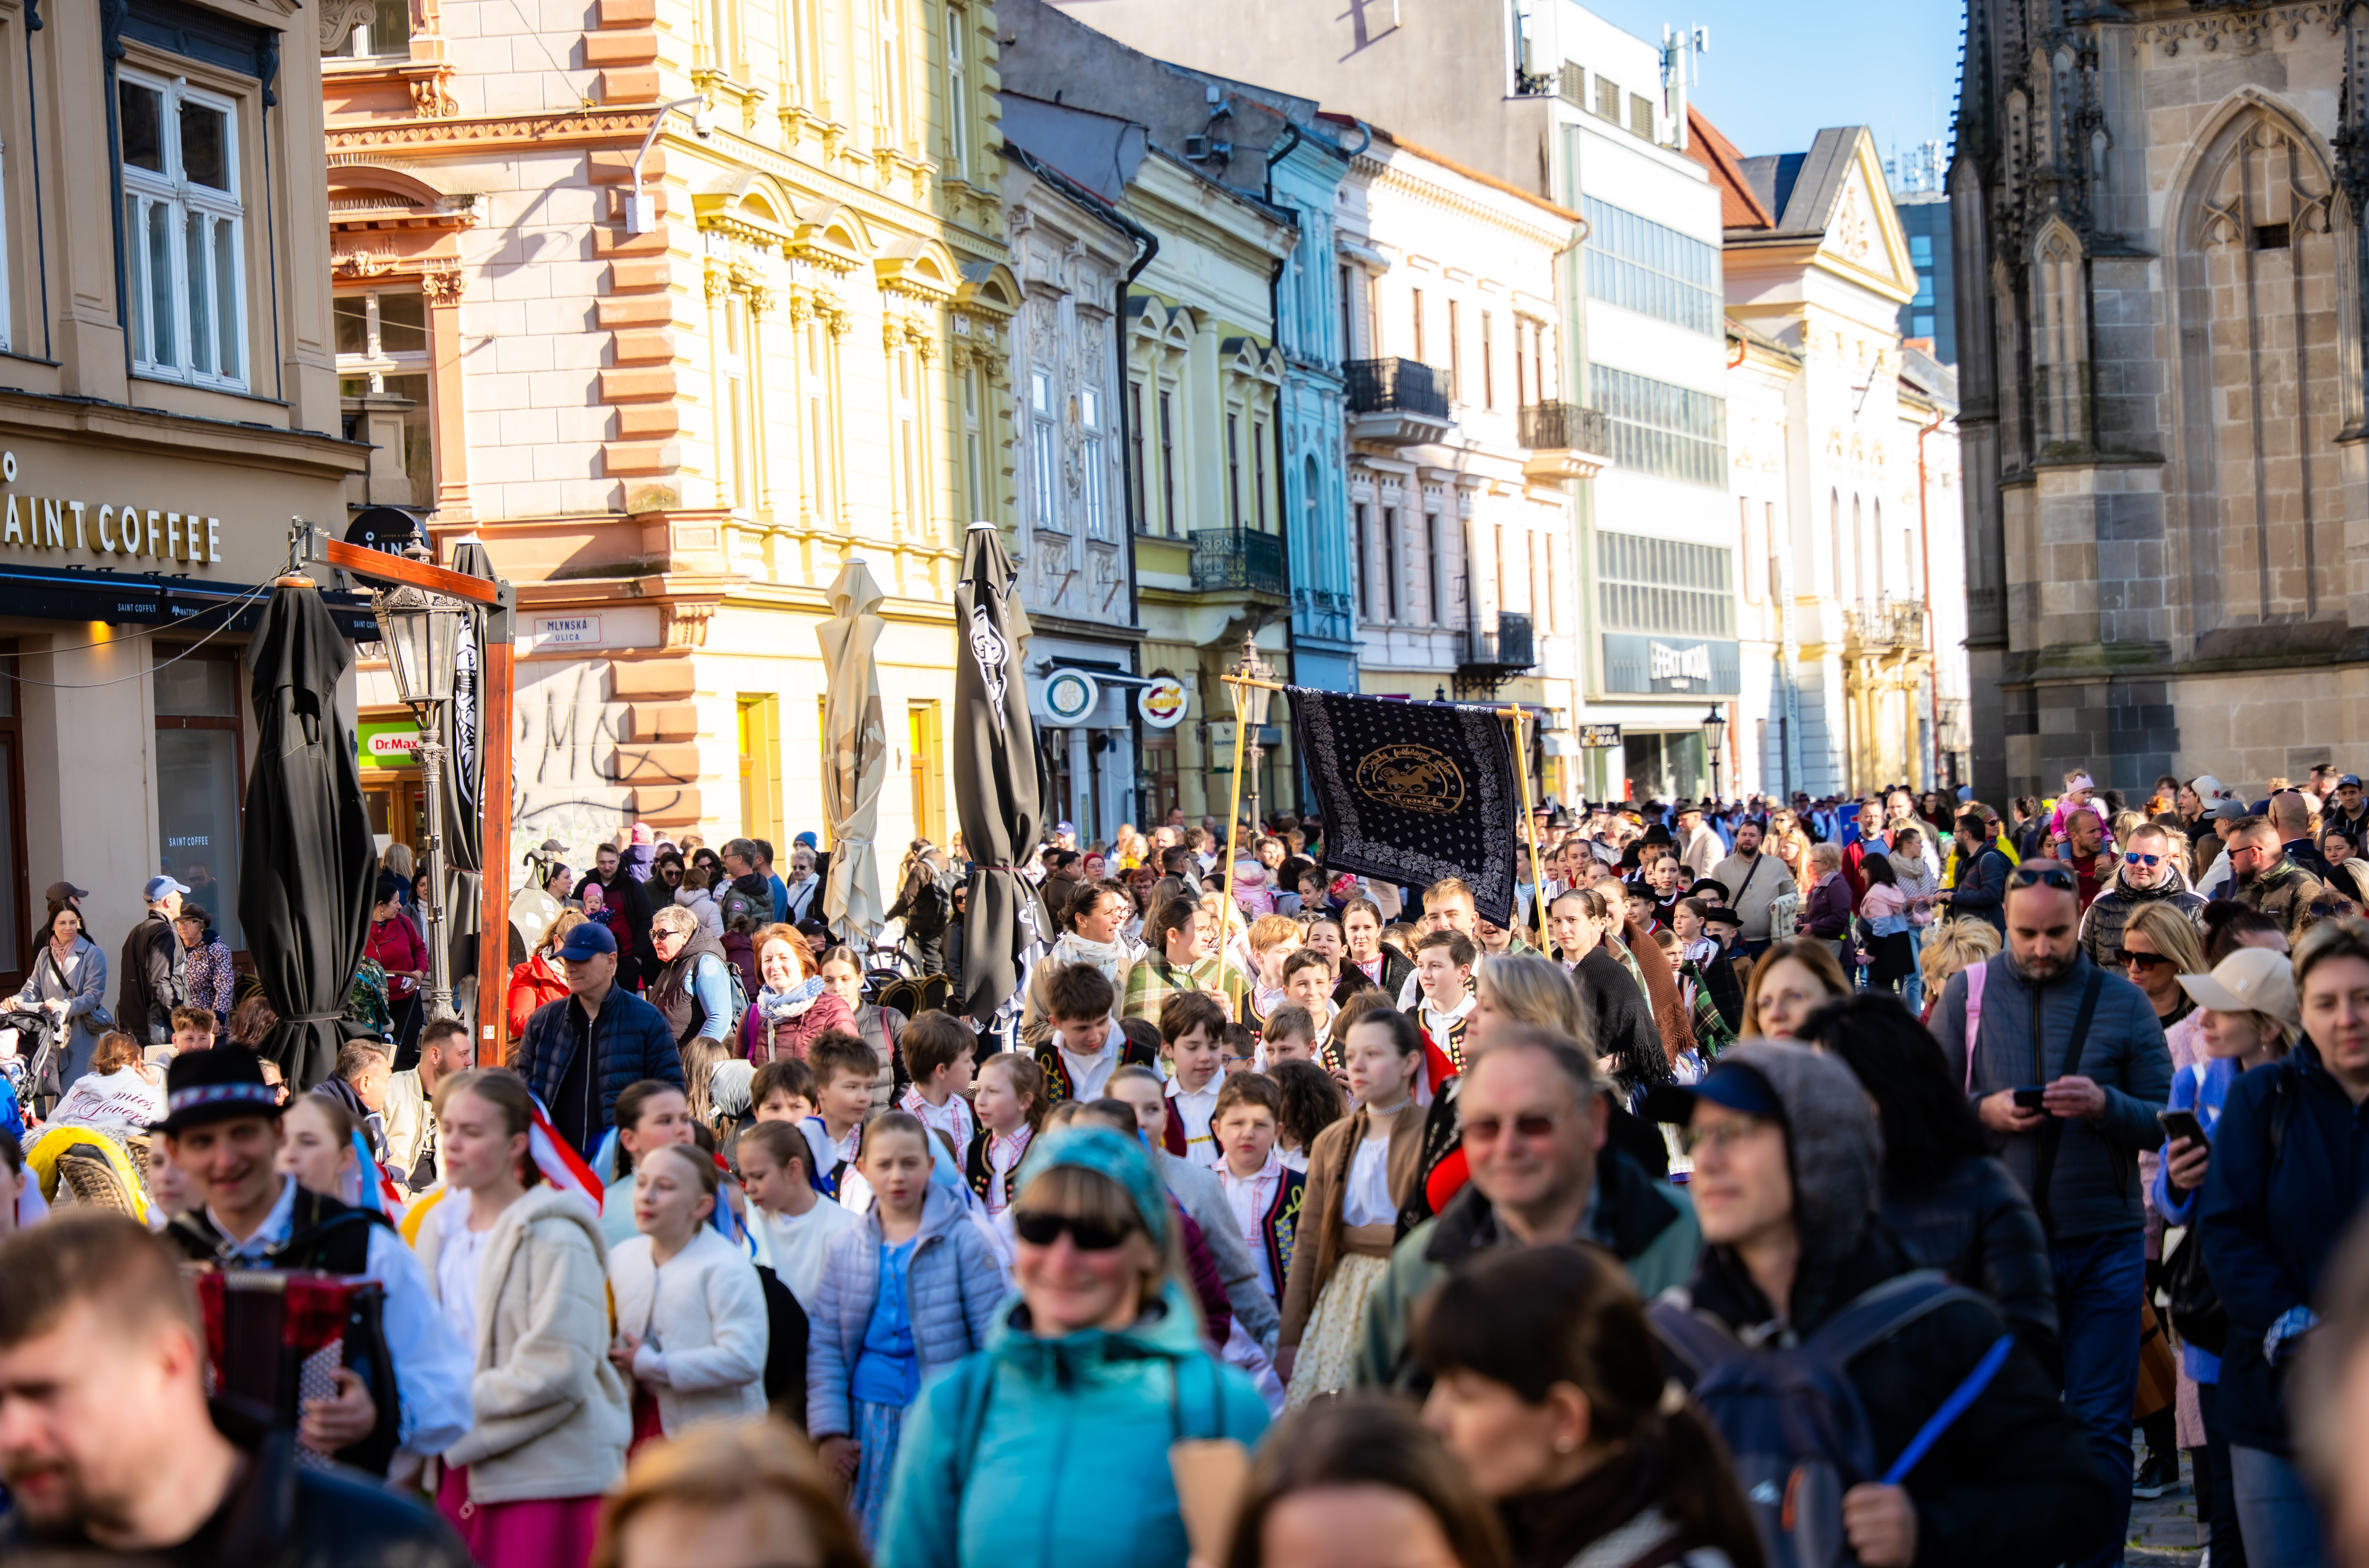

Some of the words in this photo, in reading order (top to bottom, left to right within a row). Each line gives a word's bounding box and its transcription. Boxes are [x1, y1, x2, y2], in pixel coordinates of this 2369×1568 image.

[4, 493, 84, 549] AINT
[98, 503, 221, 563] COFFEE
[118, 603, 133, 611] SAINT
[135, 604, 156, 612] COFFEE
[366, 621, 379, 629] COFF
[548, 617, 587, 631] MLYNSKÁ
[375, 738, 418, 749] Dr.Max
[169, 837, 186, 846] SAINT
[187, 836, 208, 846] COFFEE
